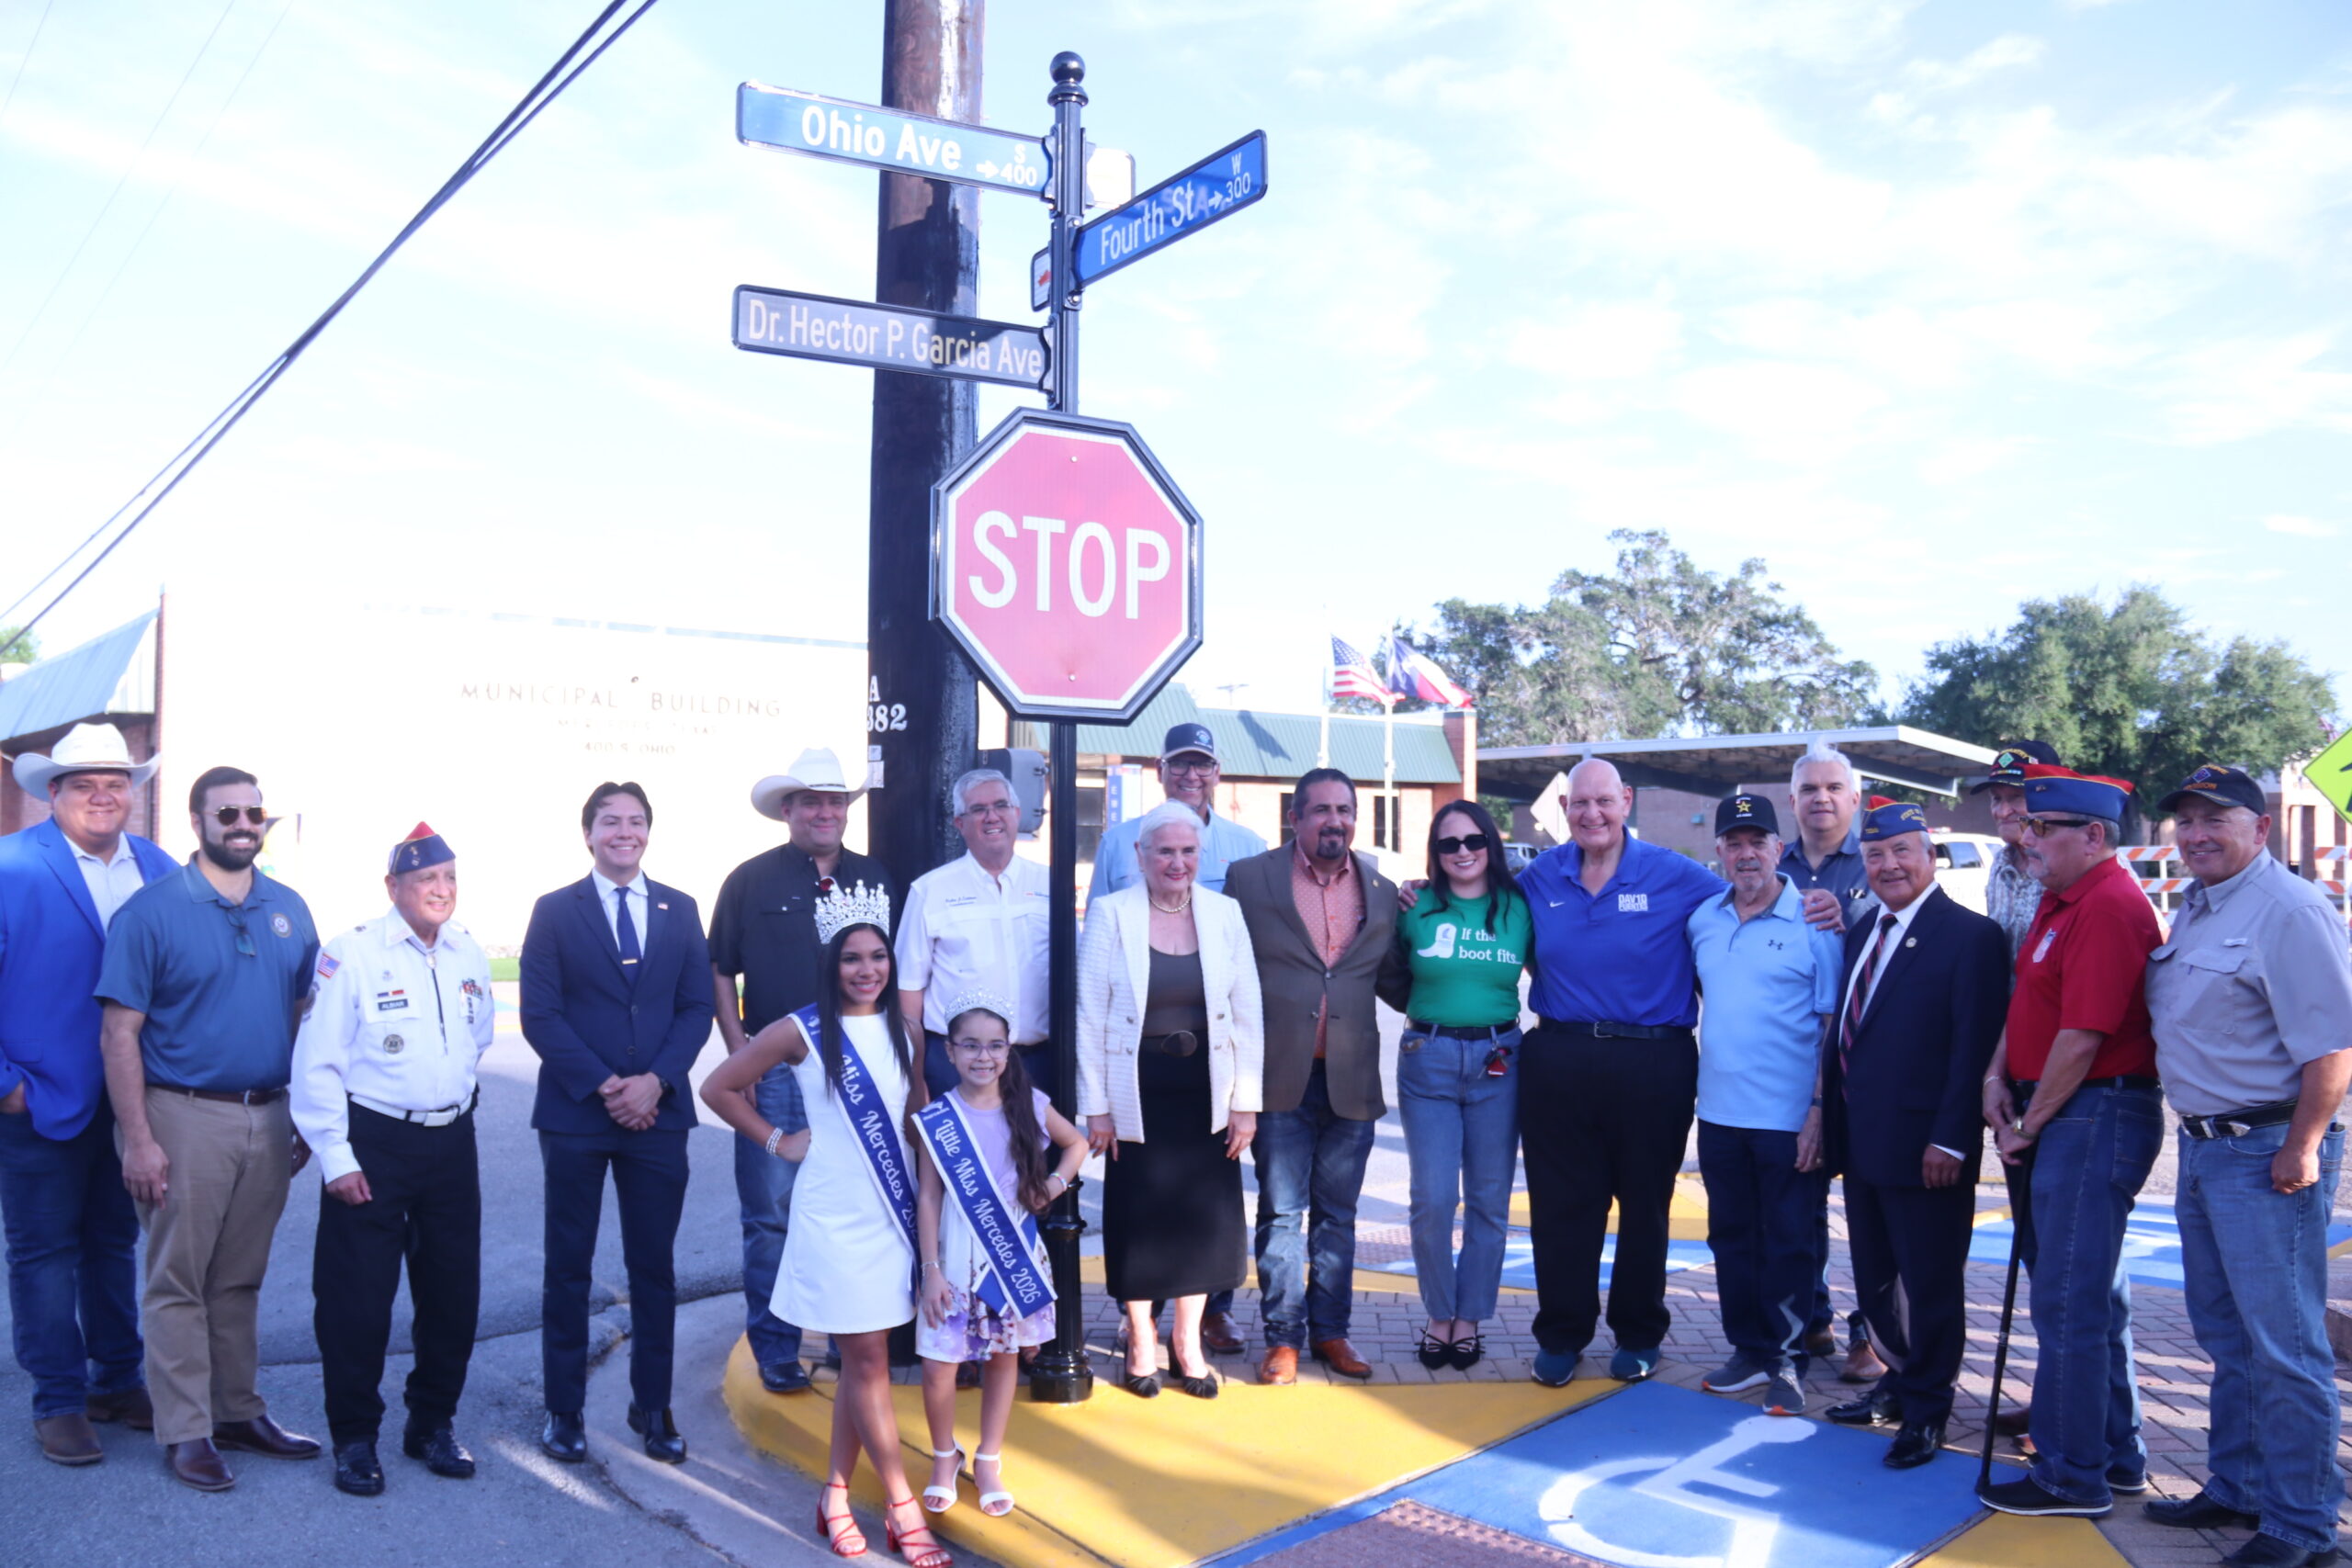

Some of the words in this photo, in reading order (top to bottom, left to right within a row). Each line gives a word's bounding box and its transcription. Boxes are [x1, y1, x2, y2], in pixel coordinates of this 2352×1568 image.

[801, 105, 886, 157] Ohio
[896, 123, 962, 171] Ave
[1013, 143, 1026, 164] S
[1001, 164, 1037, 186] 400
[1231, 152, 1242, 176] W
[1226, 172, 1250, 203] 300
[1101, 199, 1164, 265] Fourth
[1170, 180, 1194, 228] St
[748, 299, 784, 344] Dr.
[790, 305, 879, 355] Hector
[887, 319, 905, 359] P.
[911, 322, 990, 370] Garcia
[997, 336, 1043, 378] Ave
[968, 510, 1171, 620] STOP
[461, 682, 617, 708] MUNICIPAL
[651, 692, 780, 717] BUILDING
[869, 675, 880, 702] A
[1461, 927, 1472, 941] If
[1475, 929, 1496, 942] the
[1458, 945, 1492, 961] boot
[841, 1055, 865, 1106] Miss
[860, 1110, 904, 1201] Mercedes
[935, 1119, 961, 1157] Little
[953, 1157, 979, 1197] Miss
[972, 1198, 1017, 1269] Mercedes
[1011, 1268, 1042, 1303] 2026
